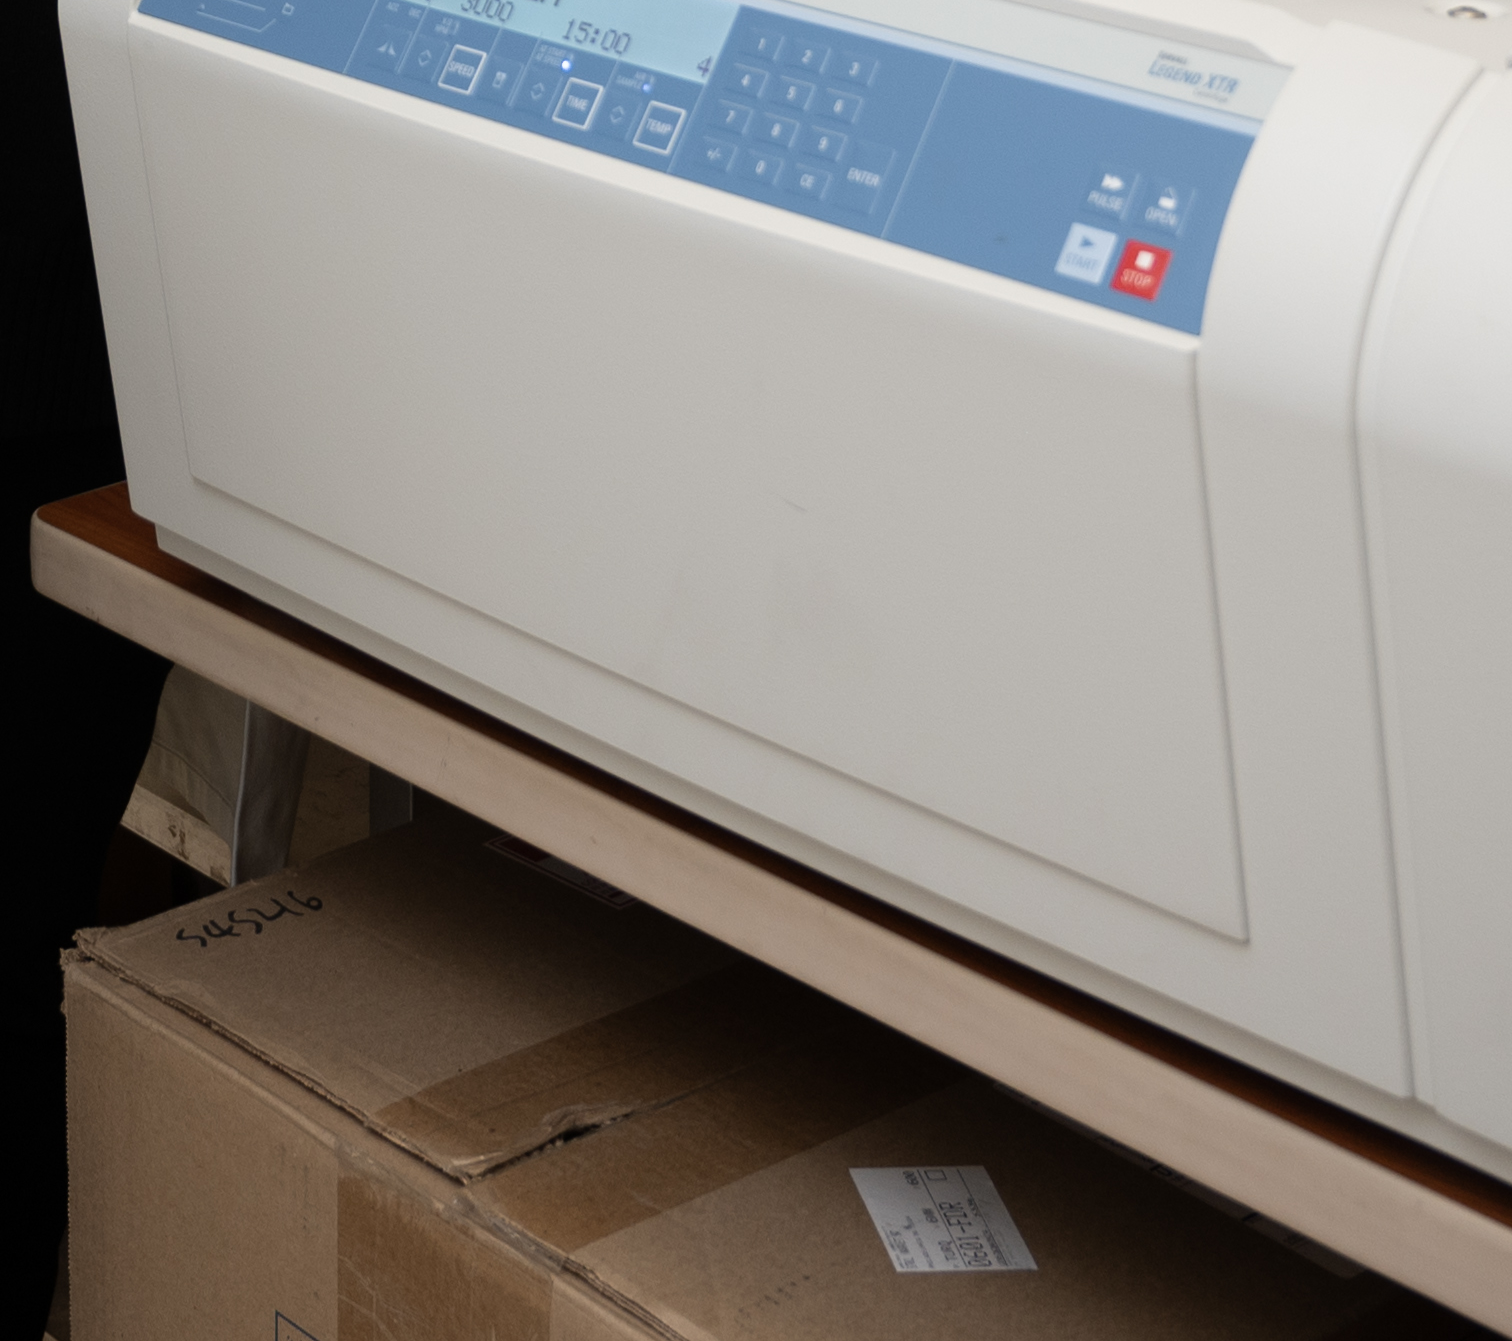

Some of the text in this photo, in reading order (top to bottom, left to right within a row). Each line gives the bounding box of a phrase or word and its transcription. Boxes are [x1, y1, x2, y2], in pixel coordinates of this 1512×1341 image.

[562, 18, 631, 55] 15:00
[696, 56, 712, 77] 4
[758, 37, 860, 76] 1 2 3
[448, 60, 475, 79] SPEED
[741, 74, 844, 114] 4 5 6
[1203, 72, 1240, 94] XTR
[567, 95, 589, 111] TIME
[646, 118, 673, 135] TEMP
[726, 110, 829, 152] 7 8 9
[755, 160, 766, 175] 0
[799, 173, 815, 189] CE
[847, 168, 880, 187] ENTER
[1087, 190, 1123, 212] PULSE
[1144, 206, 1177, 226] OPEN
[1121, 268, 1151, 286] STOP
